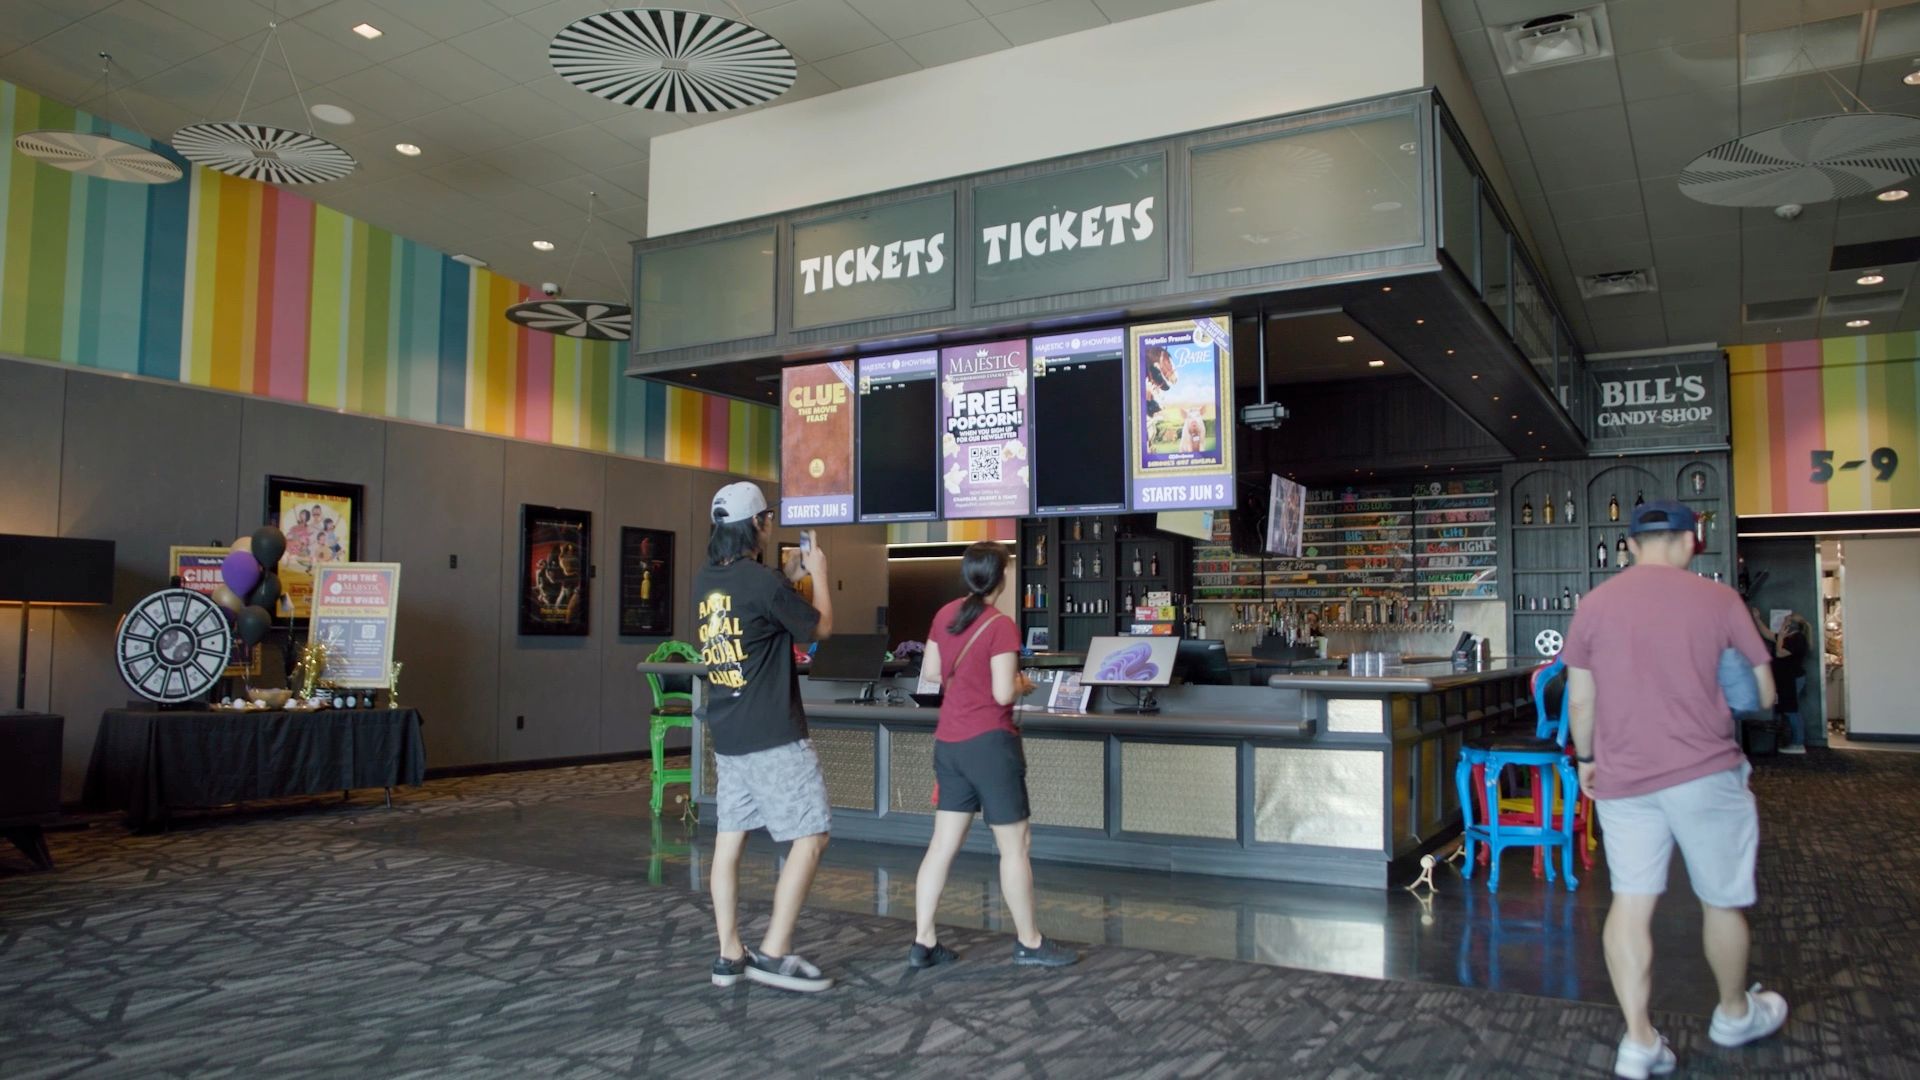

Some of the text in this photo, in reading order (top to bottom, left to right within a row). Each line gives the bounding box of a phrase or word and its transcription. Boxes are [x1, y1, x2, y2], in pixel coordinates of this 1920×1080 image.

[983, 197, 1154, 265] TICKETS
[800, 232, 944, 294] TICKETS
[1081, 335, 1122, 346] SHOWTIMES
[950, 351, 1020, 374] MAJESTIC
[789, 382, 846, 408] CLUE
[1601, 375, 1705, 408] BILL'S
[953, 388, 1017, 417] FREE
[798, 405, 837, 416] THE MOVIE
[1598, 406, 1712, 427] CANDY SHOP
[806, 414, 828, 423] FEAST
[948, 411, 1023, 431] POPCORN!
[960, 429, 977, 437] WHEN
[981, 432, 1017, 441] NEWSLETTER
[1142, 484, 1224, 502] STARTS JUN 3
[788, 504, 820, 518] STARTS
[822, 504, 839, 517] JUN
[840, 503, 847, 516] 5
[1459, 541, 1491, 552] LIGHT
[1429, 556, 1469, 567] BUD
[184, 569, 224, 582] CINE
[337, 574, 358, 582] SPIN
[324, 596, 385, 605] PRIZE WHEEL
